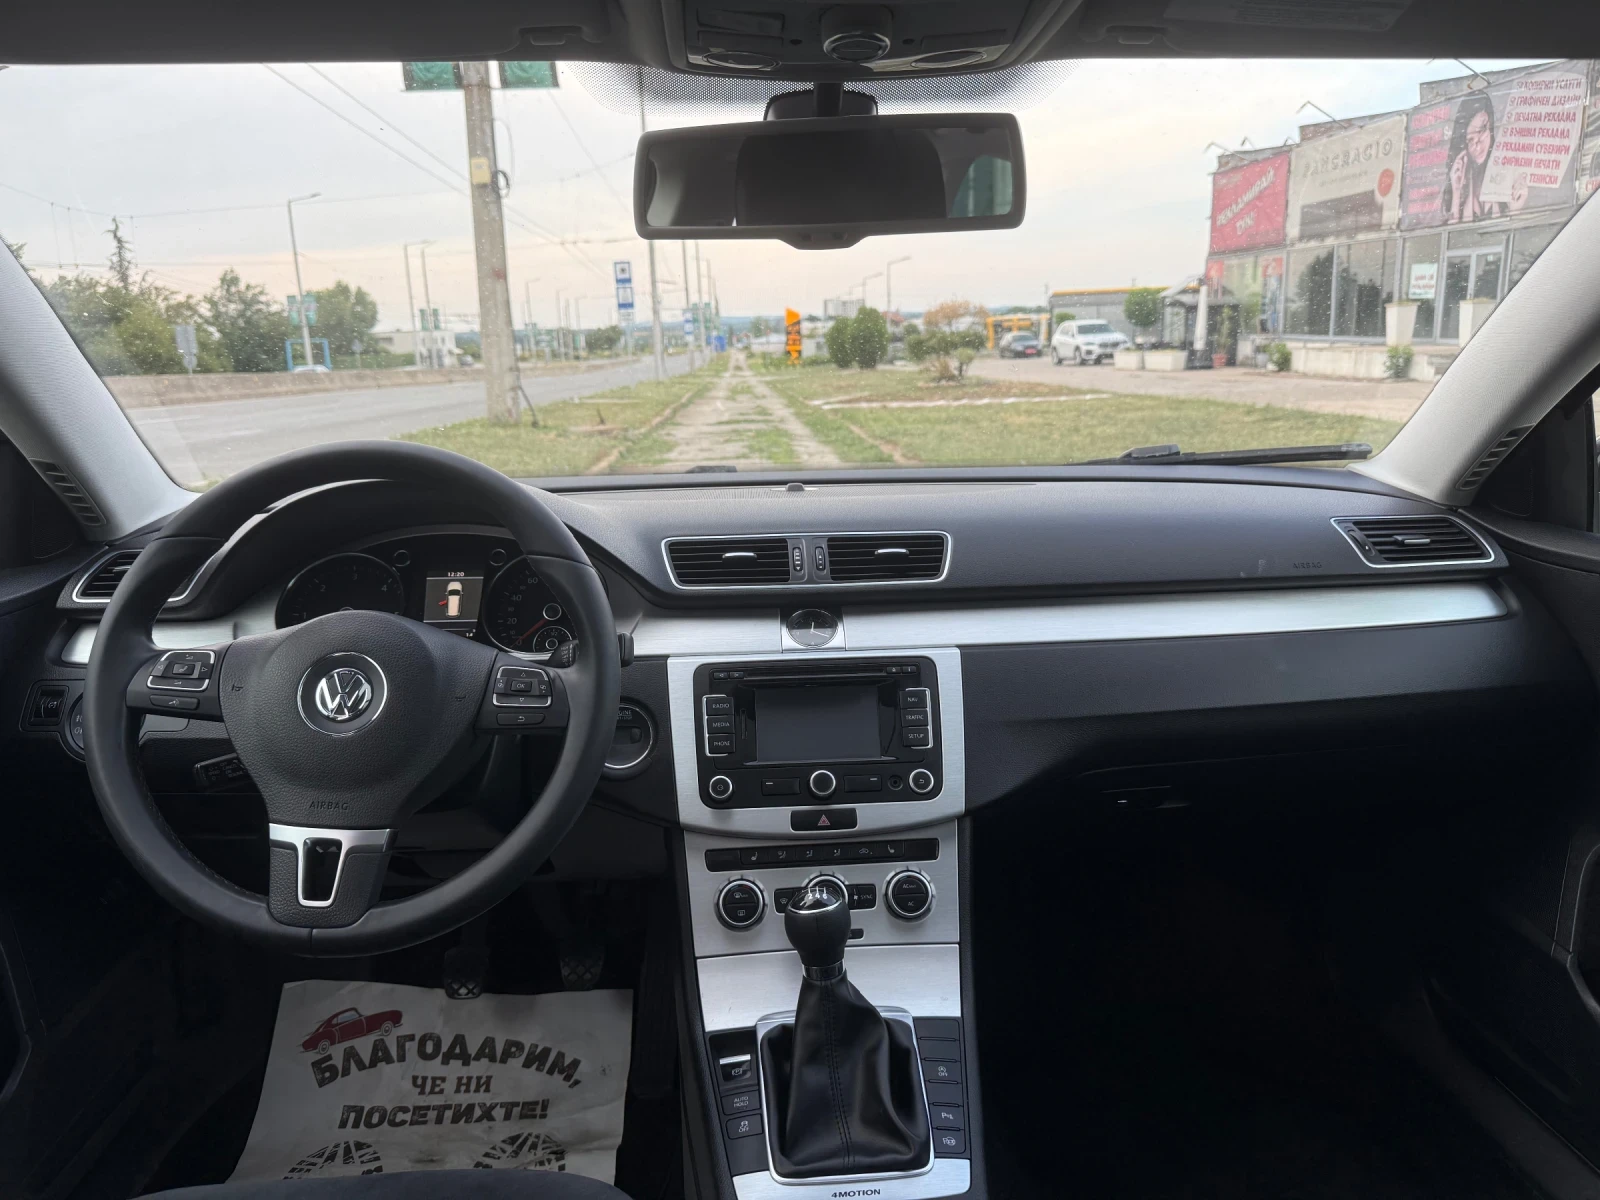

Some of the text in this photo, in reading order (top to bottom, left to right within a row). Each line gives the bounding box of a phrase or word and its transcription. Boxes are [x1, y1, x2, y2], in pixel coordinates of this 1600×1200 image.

[1516, 95, 1550, 106] ГРАФИЧЕН
[1514, 111, 1576, 122] ПЕЧАТНА РЕКЛАМА
[1509, 126, 1570, 139] ВЪНШНА РЕКЛАМА
[1502, 141, 1571, 156] РЕКЛАМНИ СУВЕНИРИ
[1534, 158, 1560, 170] ПЕЧАТИ
[1529, 173, 1559, 185] ТЕНИСКИ
[1292, 561, 1323, 569] AIRBAG
[309, 801, 349, 811] AIRBAG
[310, 1032, 582, 1089] БЛАГОДАРИМ,
[411, 1075, 493, 1096] ЧЕ НИ
[337, 1099, 550, 1130] ПОСЕТИХТЕ!
[831, 1188, 881, 1199] 4MOTION
